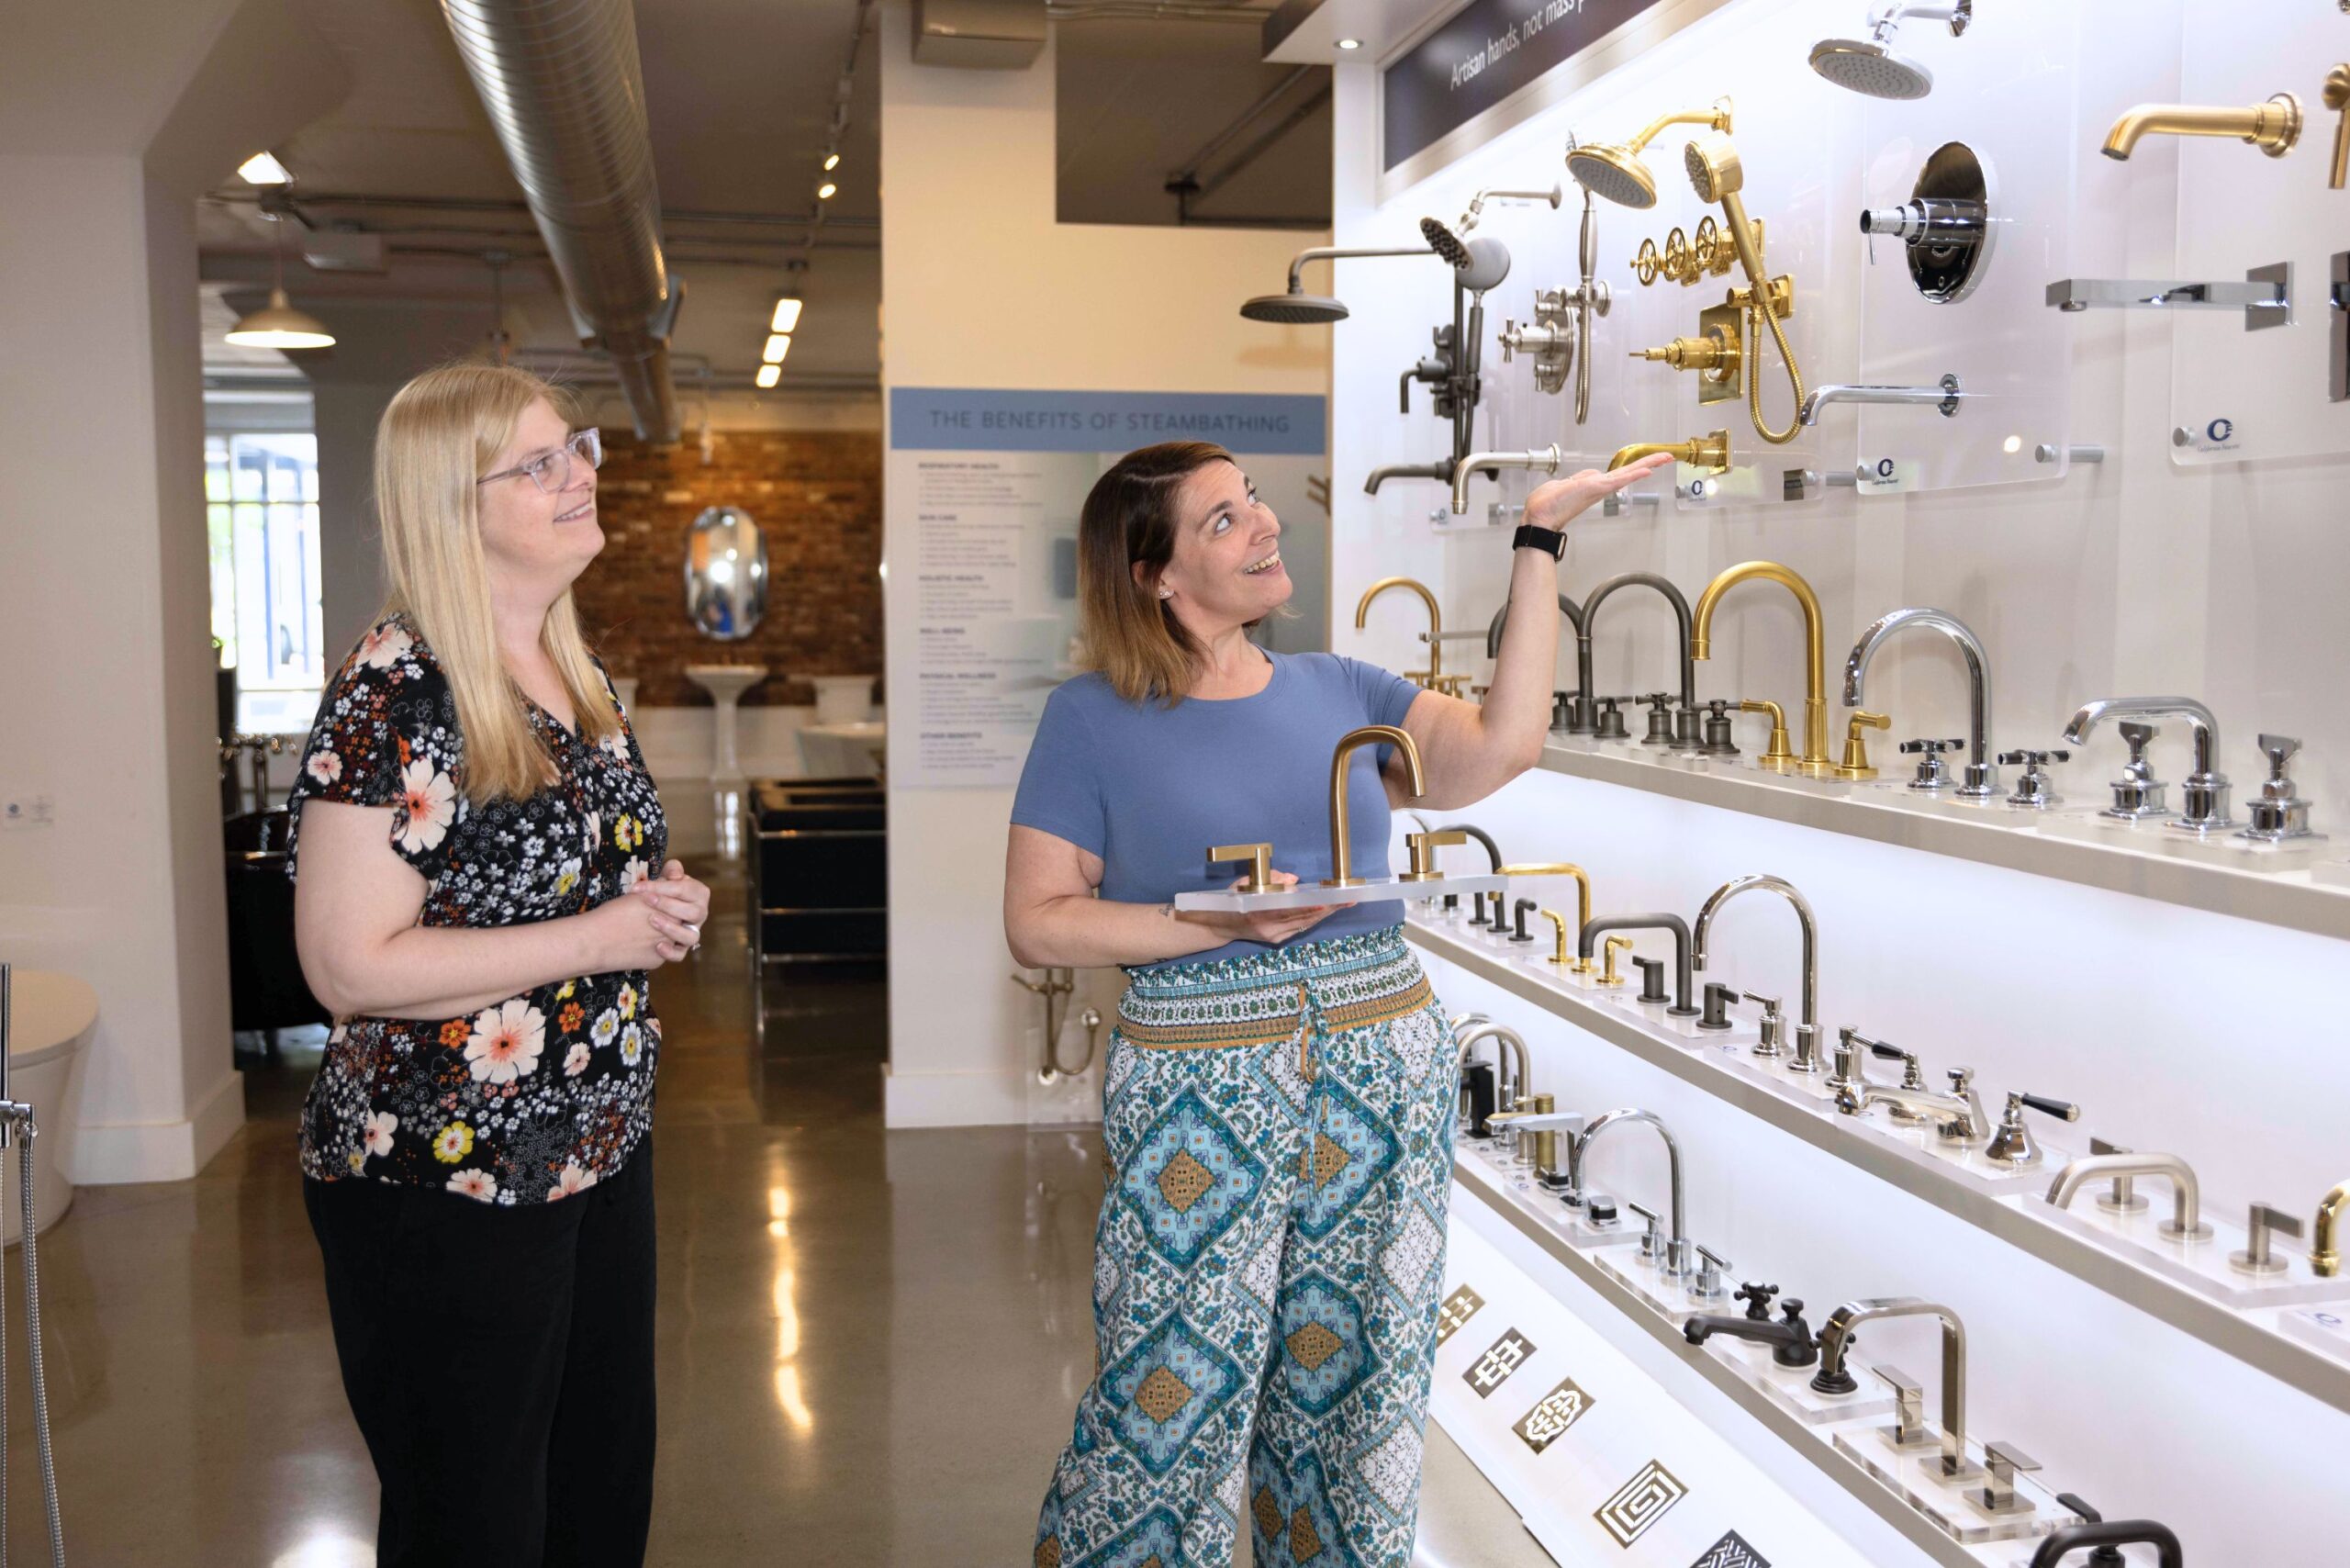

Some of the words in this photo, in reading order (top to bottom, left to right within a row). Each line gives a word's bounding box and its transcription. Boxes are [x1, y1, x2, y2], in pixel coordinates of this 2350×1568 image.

[1450, 51, 1485, 92] Artisan
[1487, 22, 1520, 65] hands,
[1523, 9, 1543, 41] not
[1546, 0, 1574, 26] mass
[930, 409, 971, 429] THE
[981, 409, 1082, 431] BENEFITS
[1090, 410, 1117, 430] OF
[1127, 411, 1291, 434] STEAMBATHING
